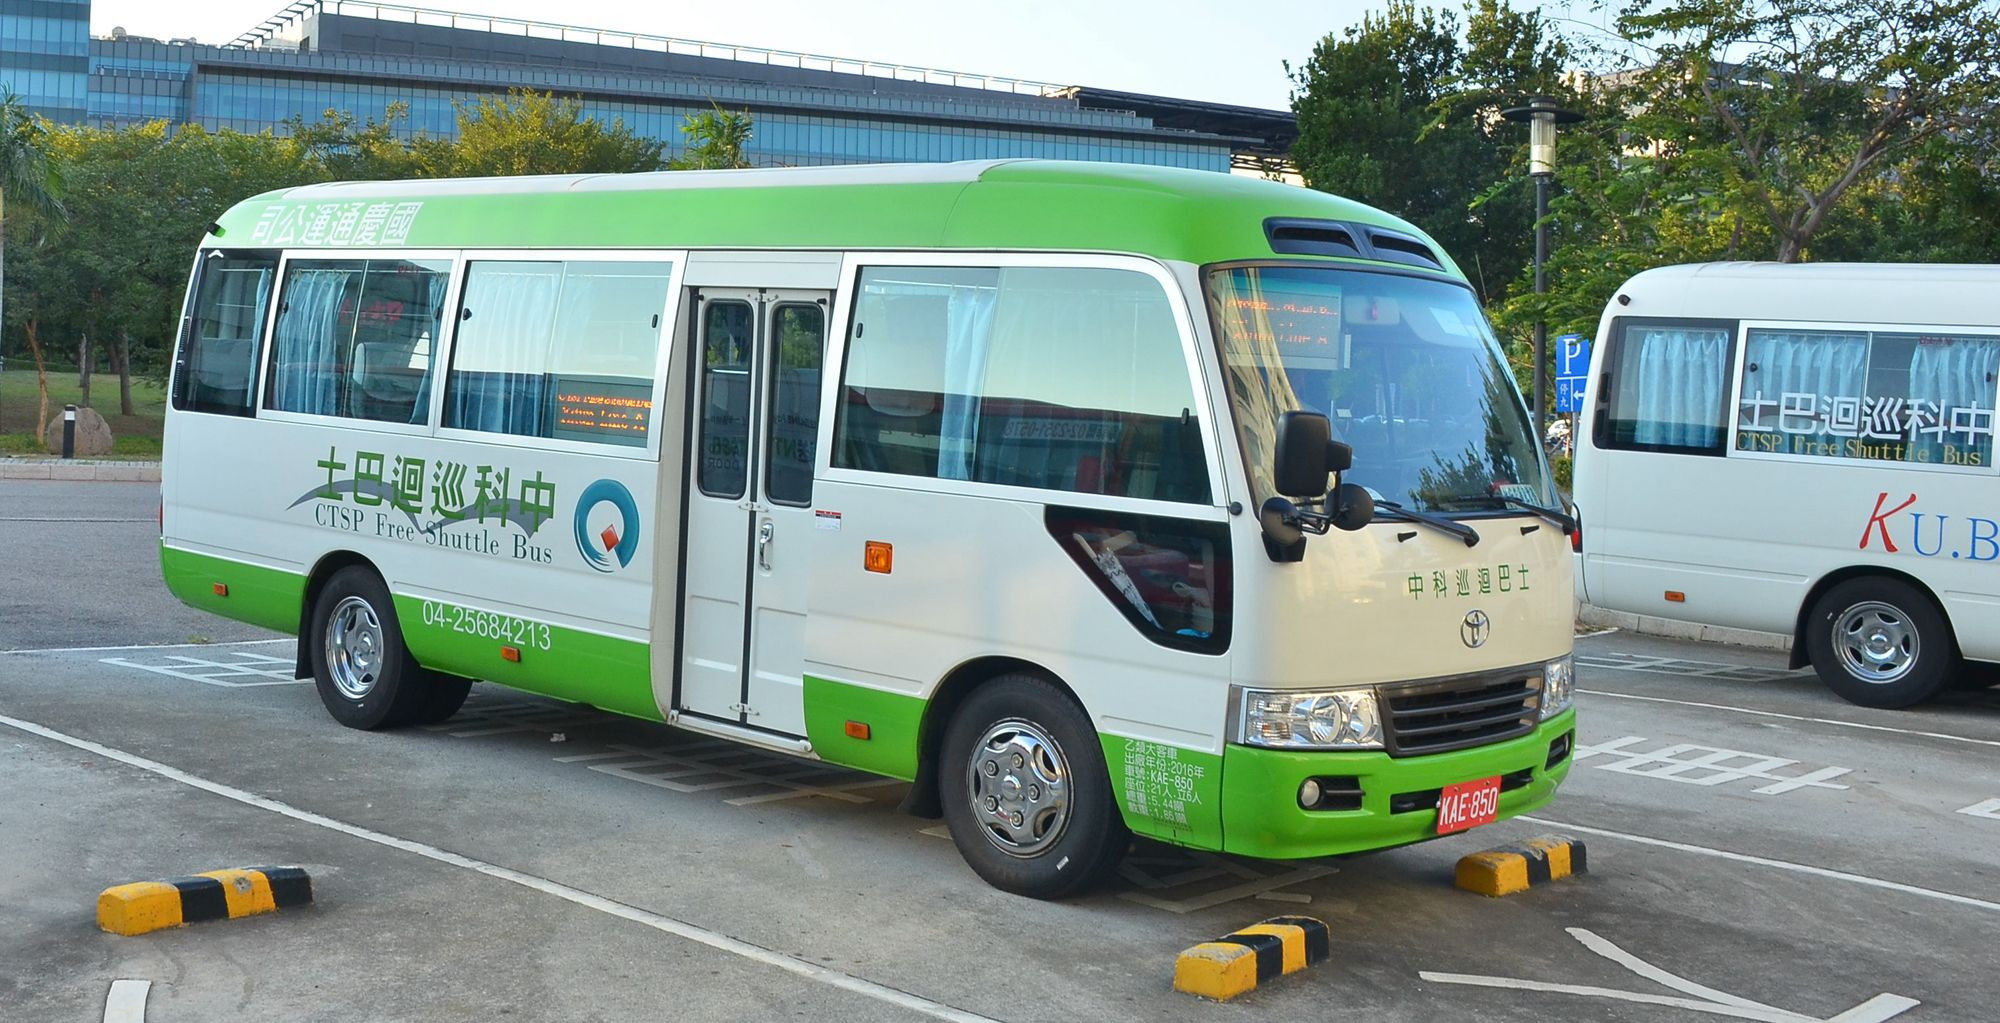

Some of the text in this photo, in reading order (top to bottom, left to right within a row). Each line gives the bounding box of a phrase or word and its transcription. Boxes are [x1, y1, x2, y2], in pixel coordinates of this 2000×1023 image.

[1563, 338, 1581, 375] P
[1736, 432, 1982, 466] CTSP Free Shuttle Bus
[315, 503, 552, 564] CTSP Free Shuttle Bus
[422, 601, 551, 650] 04-25684213
